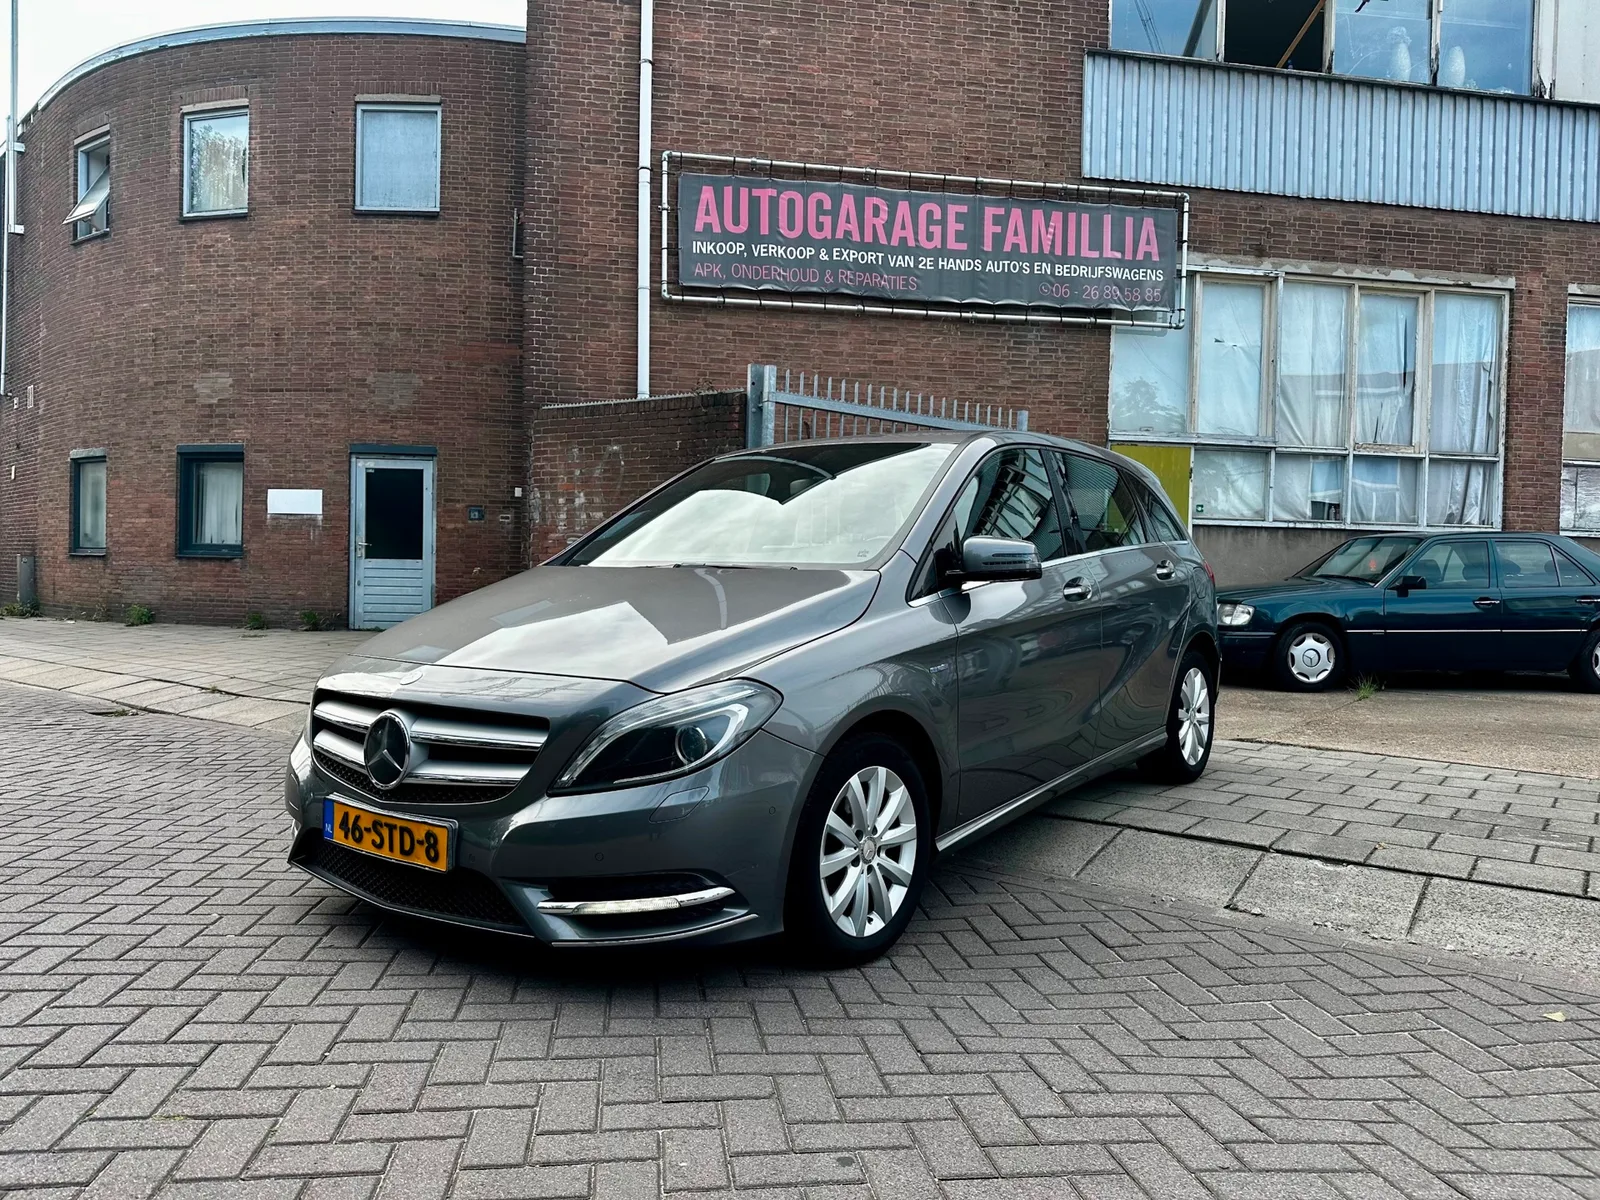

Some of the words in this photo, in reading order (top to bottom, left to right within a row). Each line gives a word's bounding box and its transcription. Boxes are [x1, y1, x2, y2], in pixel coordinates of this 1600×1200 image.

[695, 185, 968, 251] AUTOGARAGE
[984, 206, 1160, 262] FAMILLIA
[692, 241, 747, 257] INKOOP,
[752, 244, 815, 260] VERKOOP
[819, 249, 829, 261] &
[833, 248, 884, 266] EXPORT
[888, 255, 914, 269] VAN
[918, 257, 934, 270] 2E
[938, 257, 982, 272] HANDS
[986, 260, 1030, 274] AUTO'S
[1034, 262, 1050, 275] EN
[1055, 264, 1164, 282] BEDRIJFSWAGENS
[694, 263, 726, 280] APK,
[732, 263, 819, 284] ONDERHOUD
[824, 269, 834, 284] &
[839, 269, 917, 291] REPARATIES
[1053, 283, 1070, 298] 06
[1082, 285, 1099, 299] 26
[1103, 286, 1120, 300] 89
[1124, 288, 1141, 301] 58
[1145, 288, 1162, 302] 85
[325, 823, 333, 833] NL
[338, 811, 440, 863] 46-STD-8
